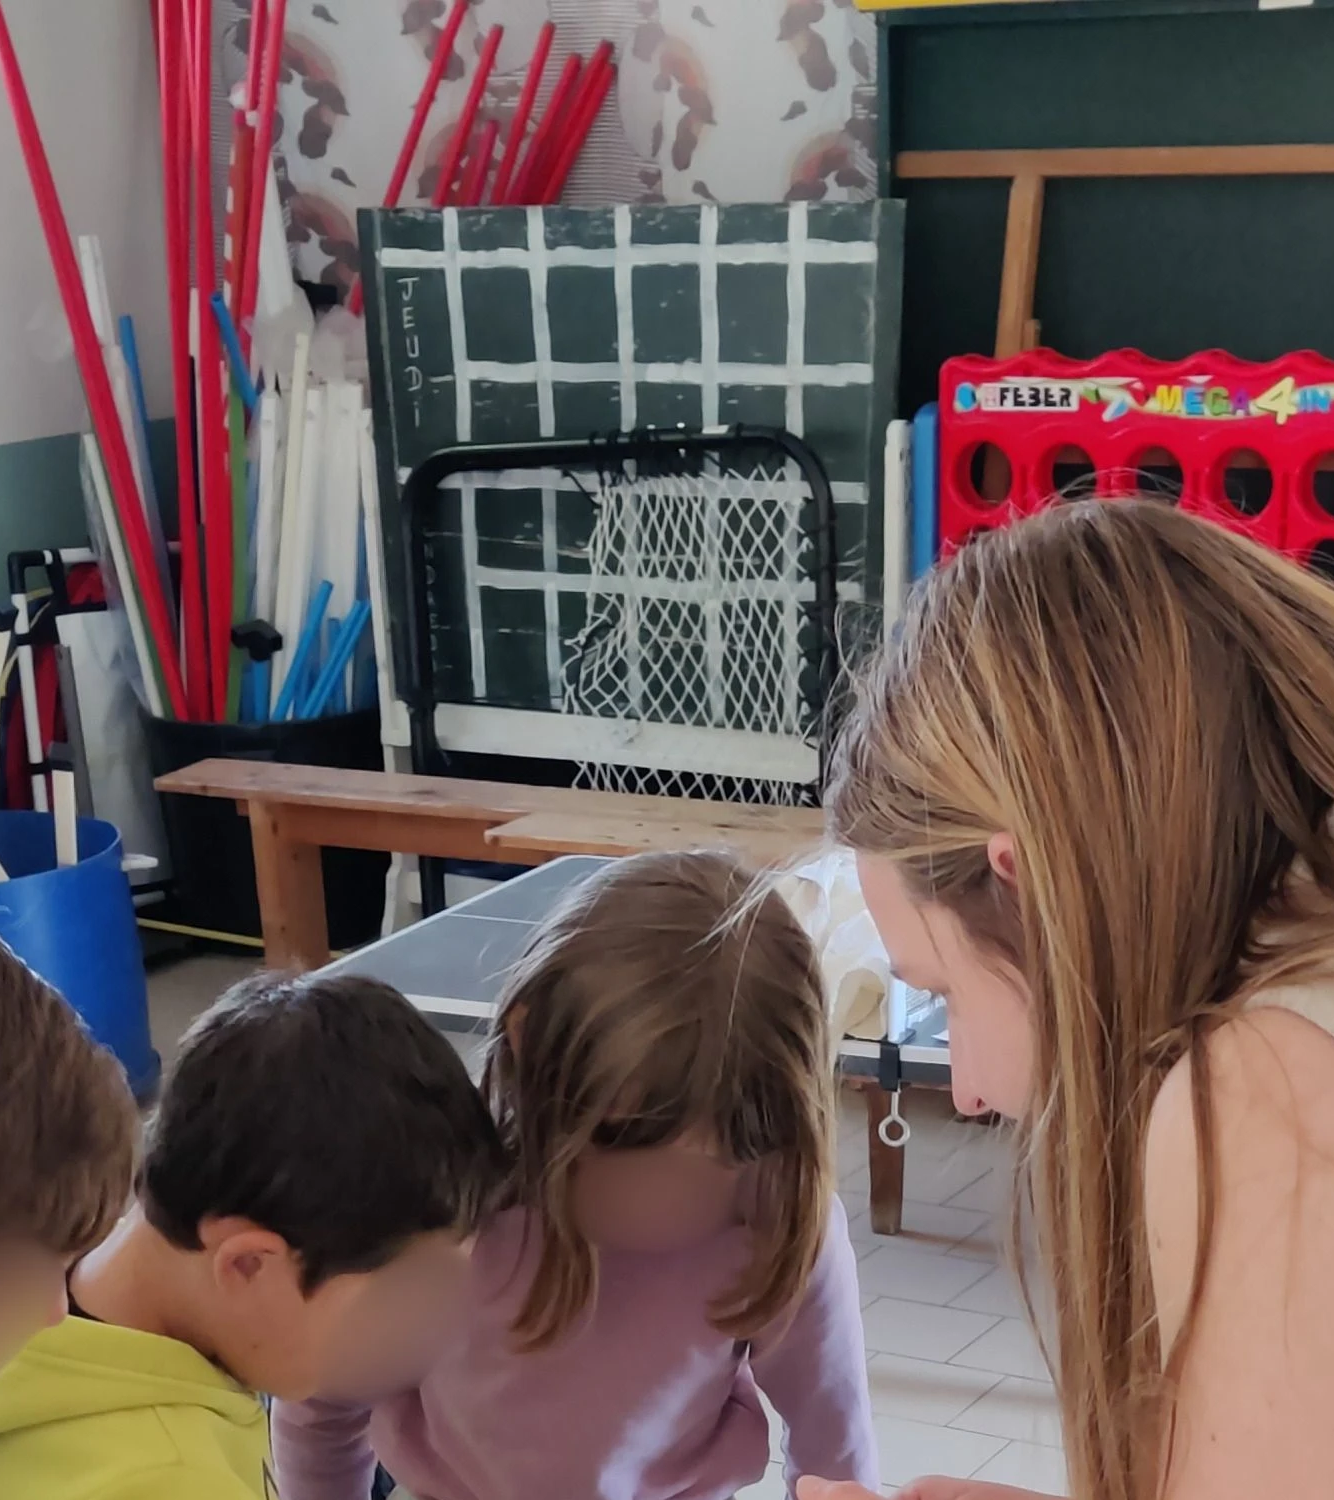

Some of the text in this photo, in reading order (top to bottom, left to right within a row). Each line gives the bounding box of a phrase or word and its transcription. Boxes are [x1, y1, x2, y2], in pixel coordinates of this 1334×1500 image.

[999, 386, 1072, 407] FEBER
[1155, 384, 1251, 416] MEGA
[1253, 375, 1298, 425] 4
[1298, 388, 1332, 413] IN
